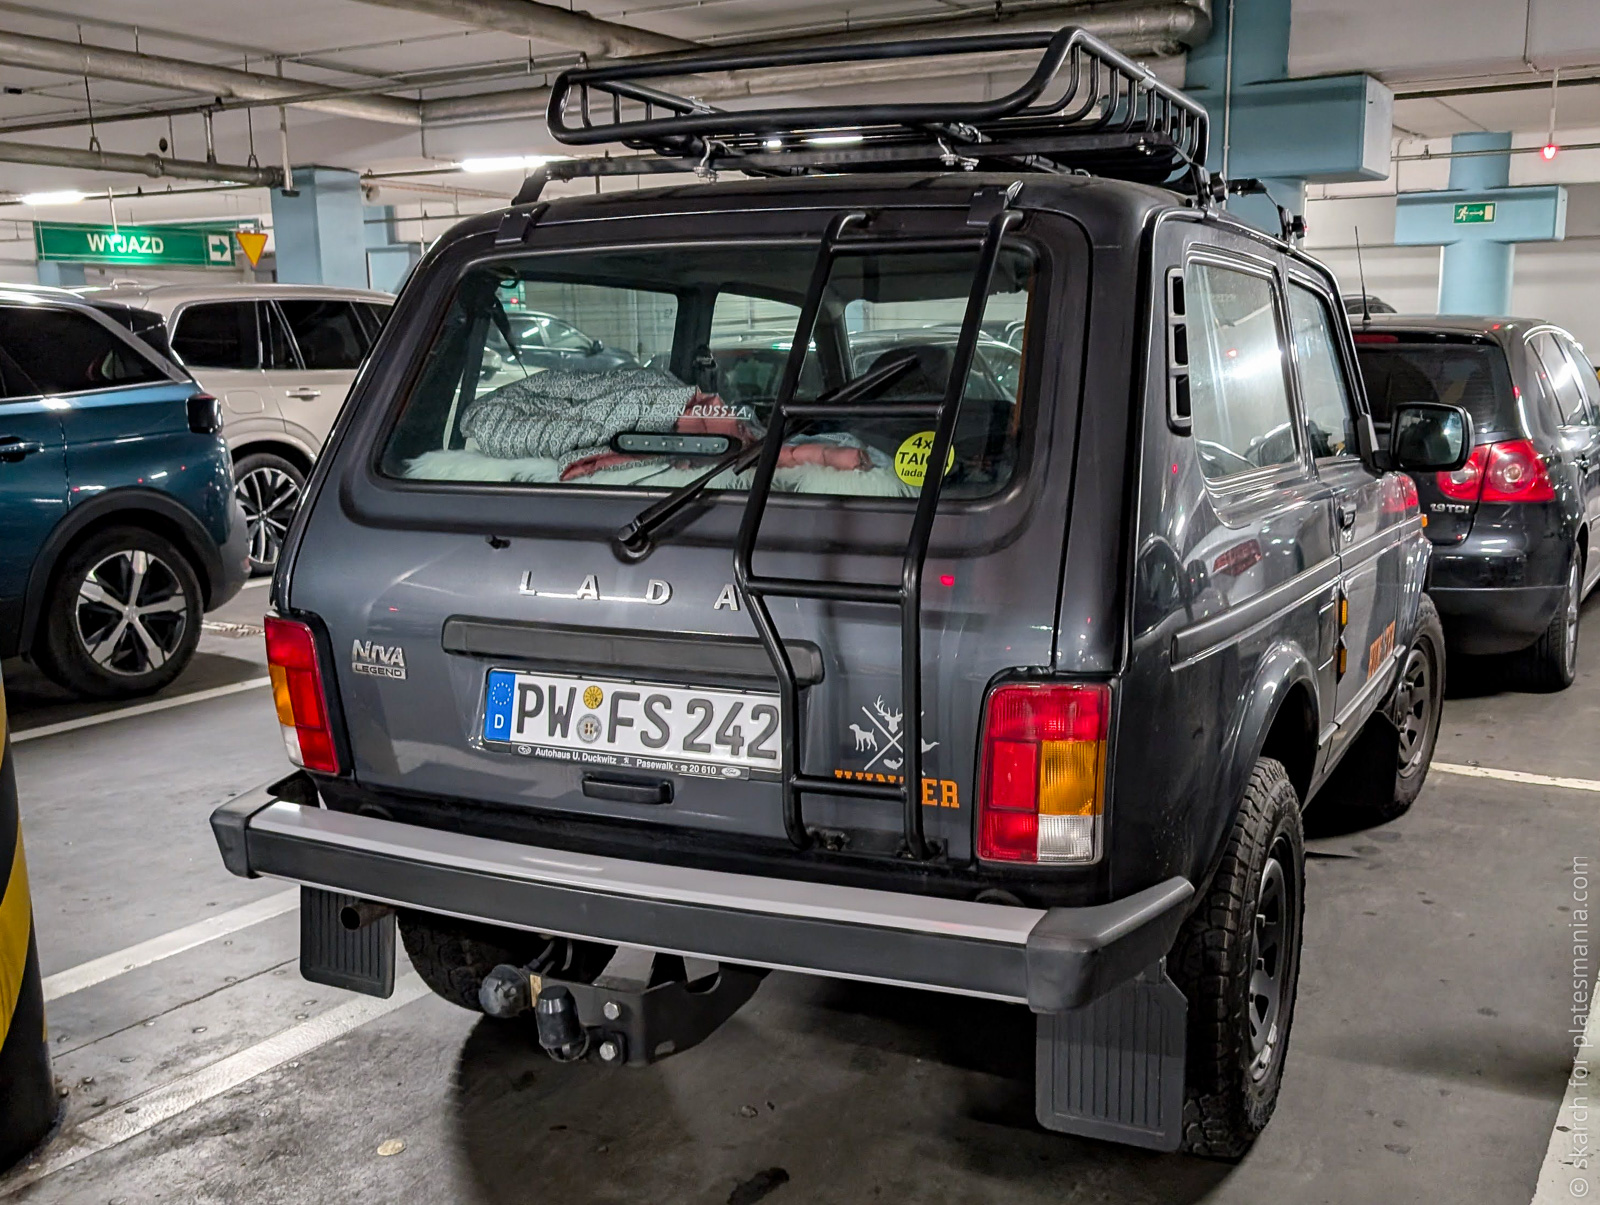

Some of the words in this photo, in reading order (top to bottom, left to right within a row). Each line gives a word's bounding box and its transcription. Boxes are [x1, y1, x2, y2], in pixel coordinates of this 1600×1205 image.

[86, 232, 164, 254] WYJAZD
[691, 404, 752, 418] RUSSIA.
[911, 436, 934, 450] 4x
[899, 451, 949, 467] TAI
[1446, 503, 1470, 514] TDI
[519, 570, 741, 611] LADA
[352, 639, 405, 667] NIVA
[355, 664, 402, 677] LEGEND
[494, 713, 504, 729] D
[516, 682, 577, 738] PW
[607, 690, 672, 748] FS
[683, 698, 780, 760] 242
[535, 747, 571, 760] Autohaus
[572, 752, 580, 761] U.
[582, 752, 617, 765] Duckwitz
[636, 758, 674, 771] Pasewalk
[689, 764, 700, 773] 20
[701, 765, 717, 775] 610
